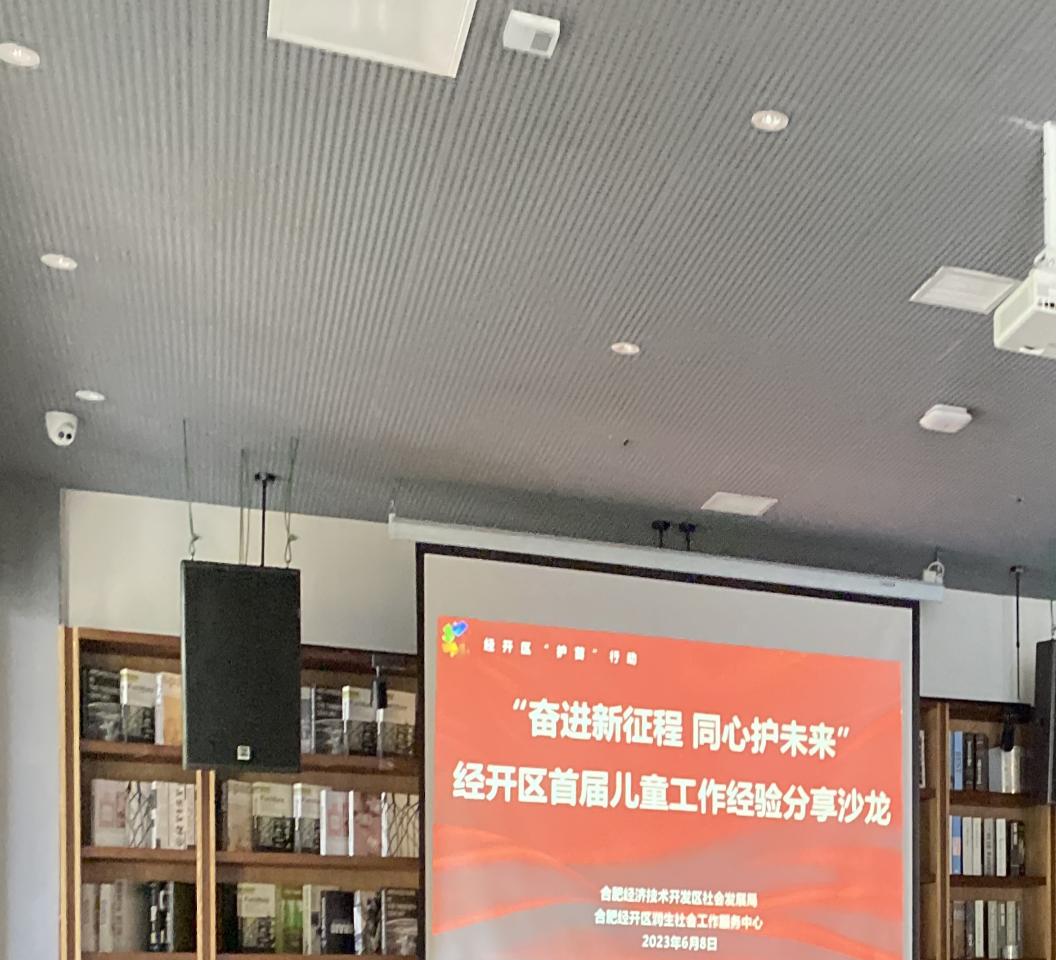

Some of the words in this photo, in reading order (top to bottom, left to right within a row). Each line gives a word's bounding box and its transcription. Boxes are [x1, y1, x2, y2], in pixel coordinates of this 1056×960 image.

[452, 761, 892, 826] 经开区首届儿童工作经验分享沙龙
[600, 885, 758, 908] 合肥经济技术开发区社会发展局
[641, 934, 718, 951] 2023年6月8日
